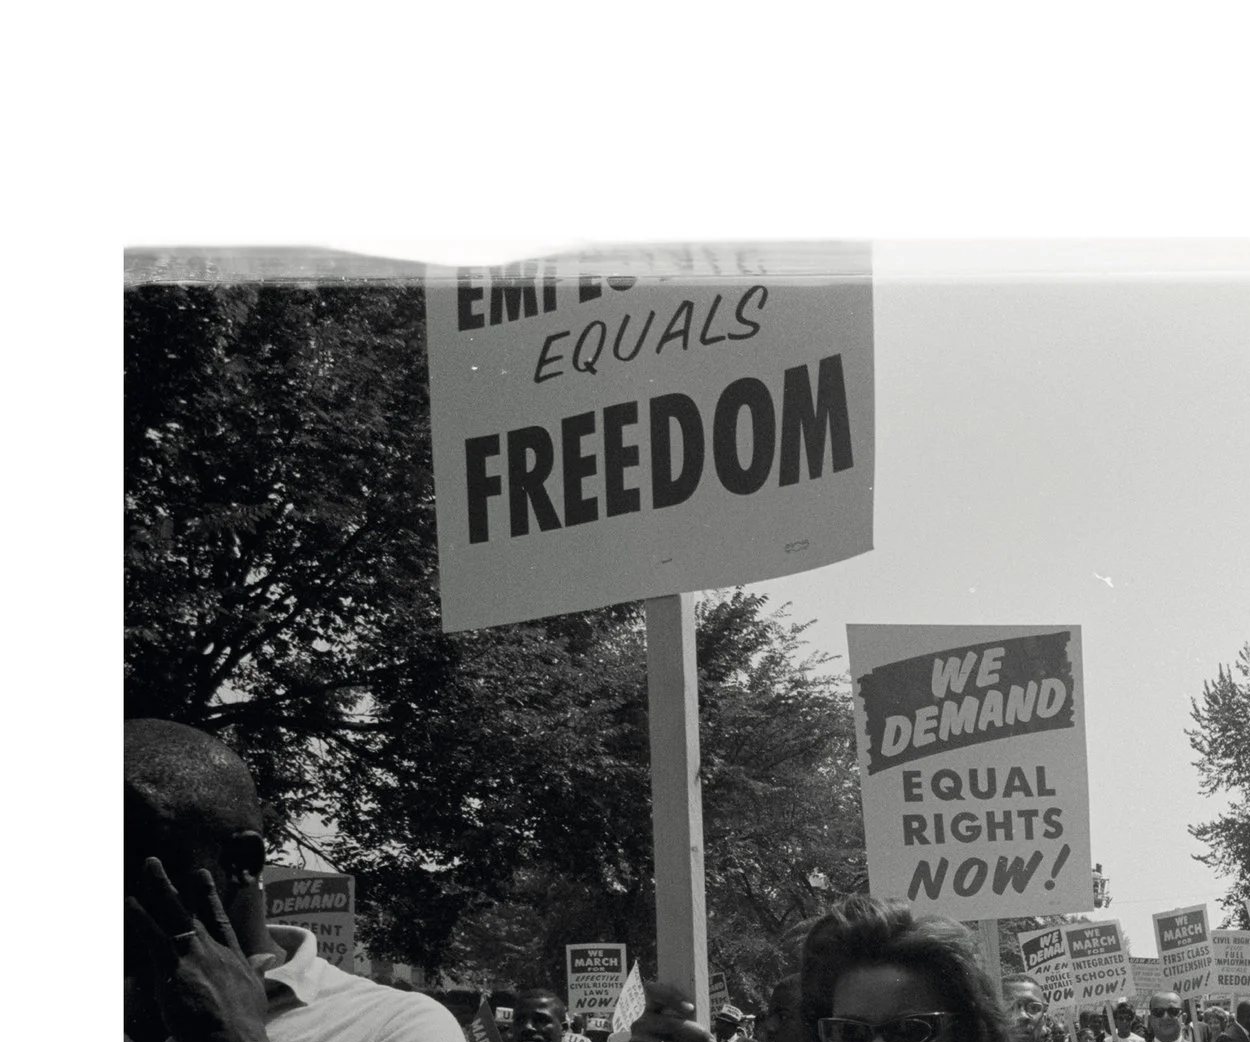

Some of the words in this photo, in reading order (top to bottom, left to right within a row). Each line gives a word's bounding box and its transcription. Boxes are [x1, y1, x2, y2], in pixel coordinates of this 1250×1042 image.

[533, 285, 768, 384] EQUALS
[464, 353, 854, 545] FREEDOM
[931, 646, 1005, 698] WE
[880, 678, 1067, 757] DEMAND
[902, 766, 1056, 802] EQUAL
[902, 807, 1064, 846] RIGHTS
[907, 843, 1071, 901] NOW!
[292, 880, 324, 896] WE
[272, 893, 347, 914] DEMAND
[1174, 915, 1189, 927] WE
[1039, 931, 1060, 948] WE
[1083, 928, 1100, 938] WE
[1163, 923, 1202, 942] MARCH
[1212, 936, 1230, 945] CIVIL
[1072, 935, 1117, 951] MARCH
[574, 957, 618, 967] MARCH
[1072, 954, 1124, 971] INTEGRATED
[1163, 951, 1185, 965] FIRST
[1187, 946, 1210, 959] CLASS
[1054, 962, 1069, 970] EN
[1075, 966, 1127, 983] SCHOOLS
[1163, 957, 1212, 978] CITIZENSHIP
[570, 982, 591, 990] CIVIL
[1045, 972, 1071, 983] POLICE
[1173, 971, 1211, 993] NOW!
[1082, 978, 1127, 998] NOW!
